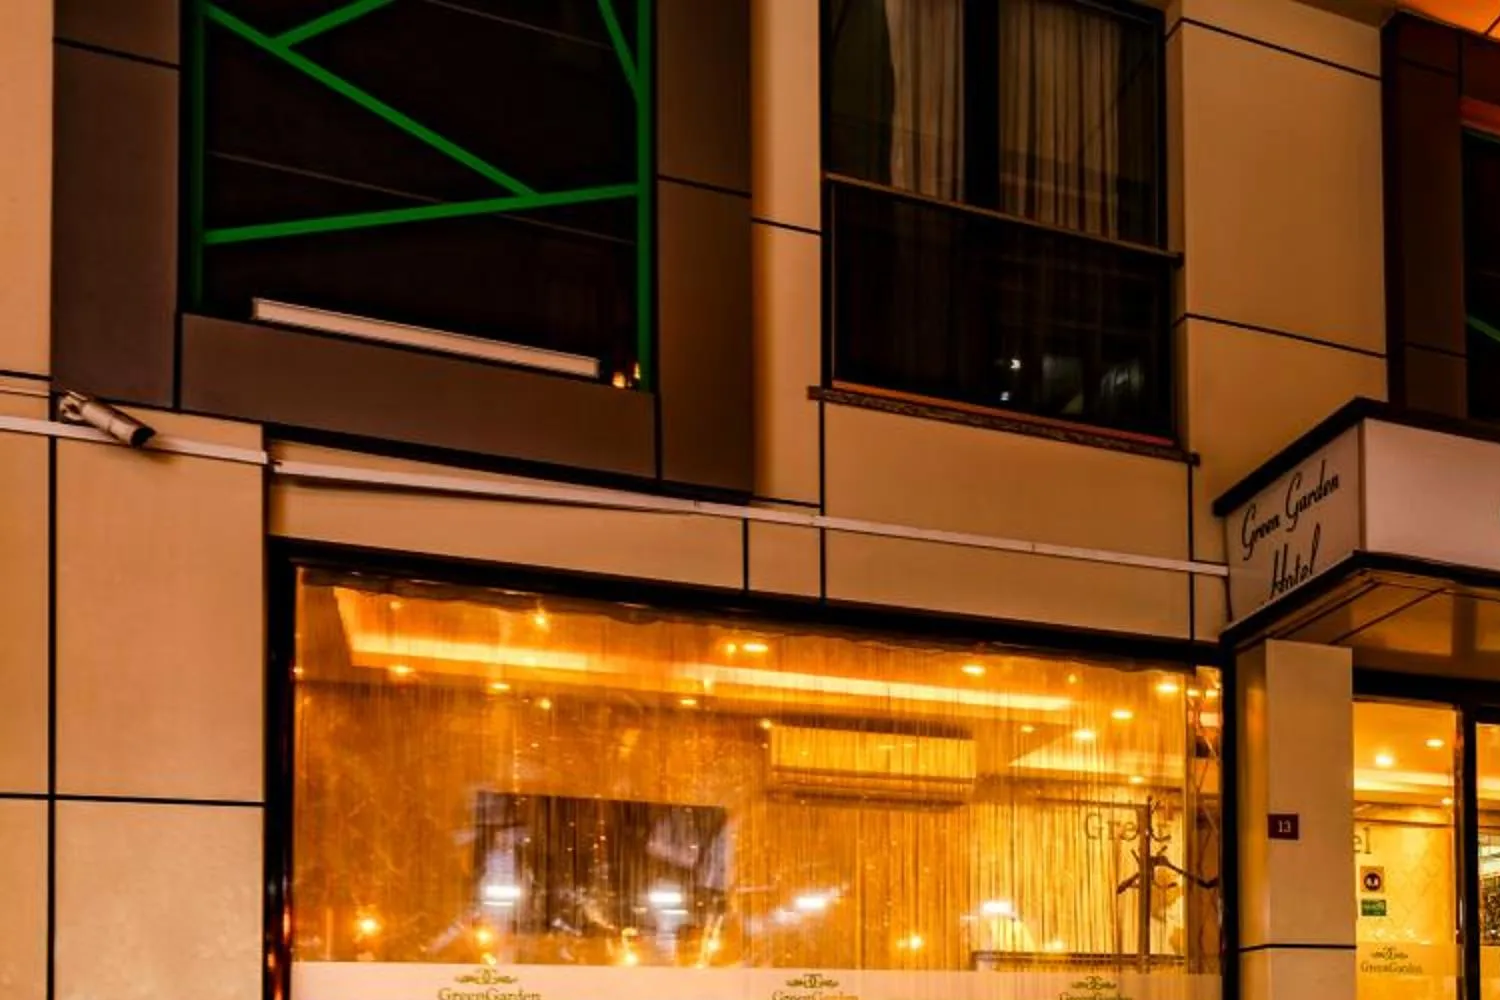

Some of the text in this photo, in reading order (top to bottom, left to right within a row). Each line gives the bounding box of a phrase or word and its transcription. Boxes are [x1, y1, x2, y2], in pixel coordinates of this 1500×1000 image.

[1241, 459, 1340, 561] Green Garden
[1266, 522, 1321, 602] Hotel
[1277, 819, 1292, 833] 13
